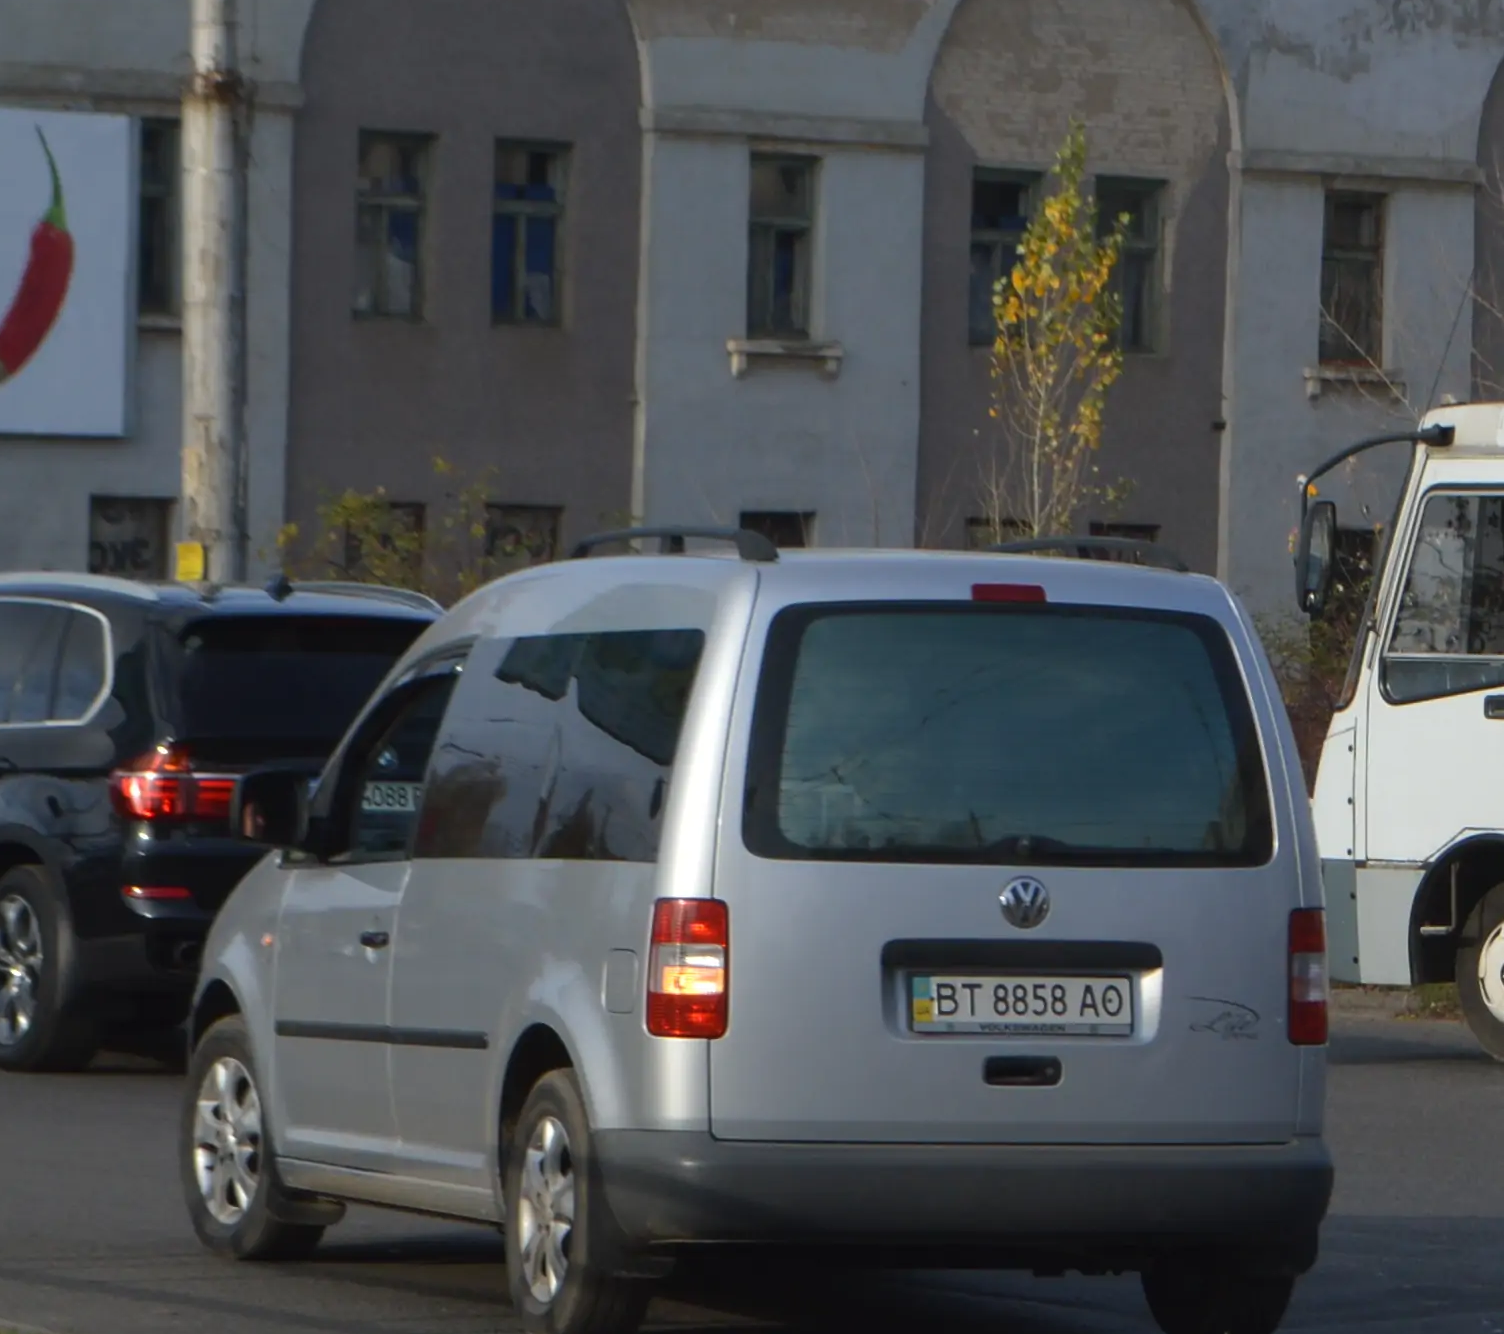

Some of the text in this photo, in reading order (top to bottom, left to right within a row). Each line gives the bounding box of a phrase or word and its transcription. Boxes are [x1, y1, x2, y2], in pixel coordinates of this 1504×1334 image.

[935, 982, 1124, 1018] BT 8858 AO
[979, 1023, 1066, 1034] VOLKSWAGEN
